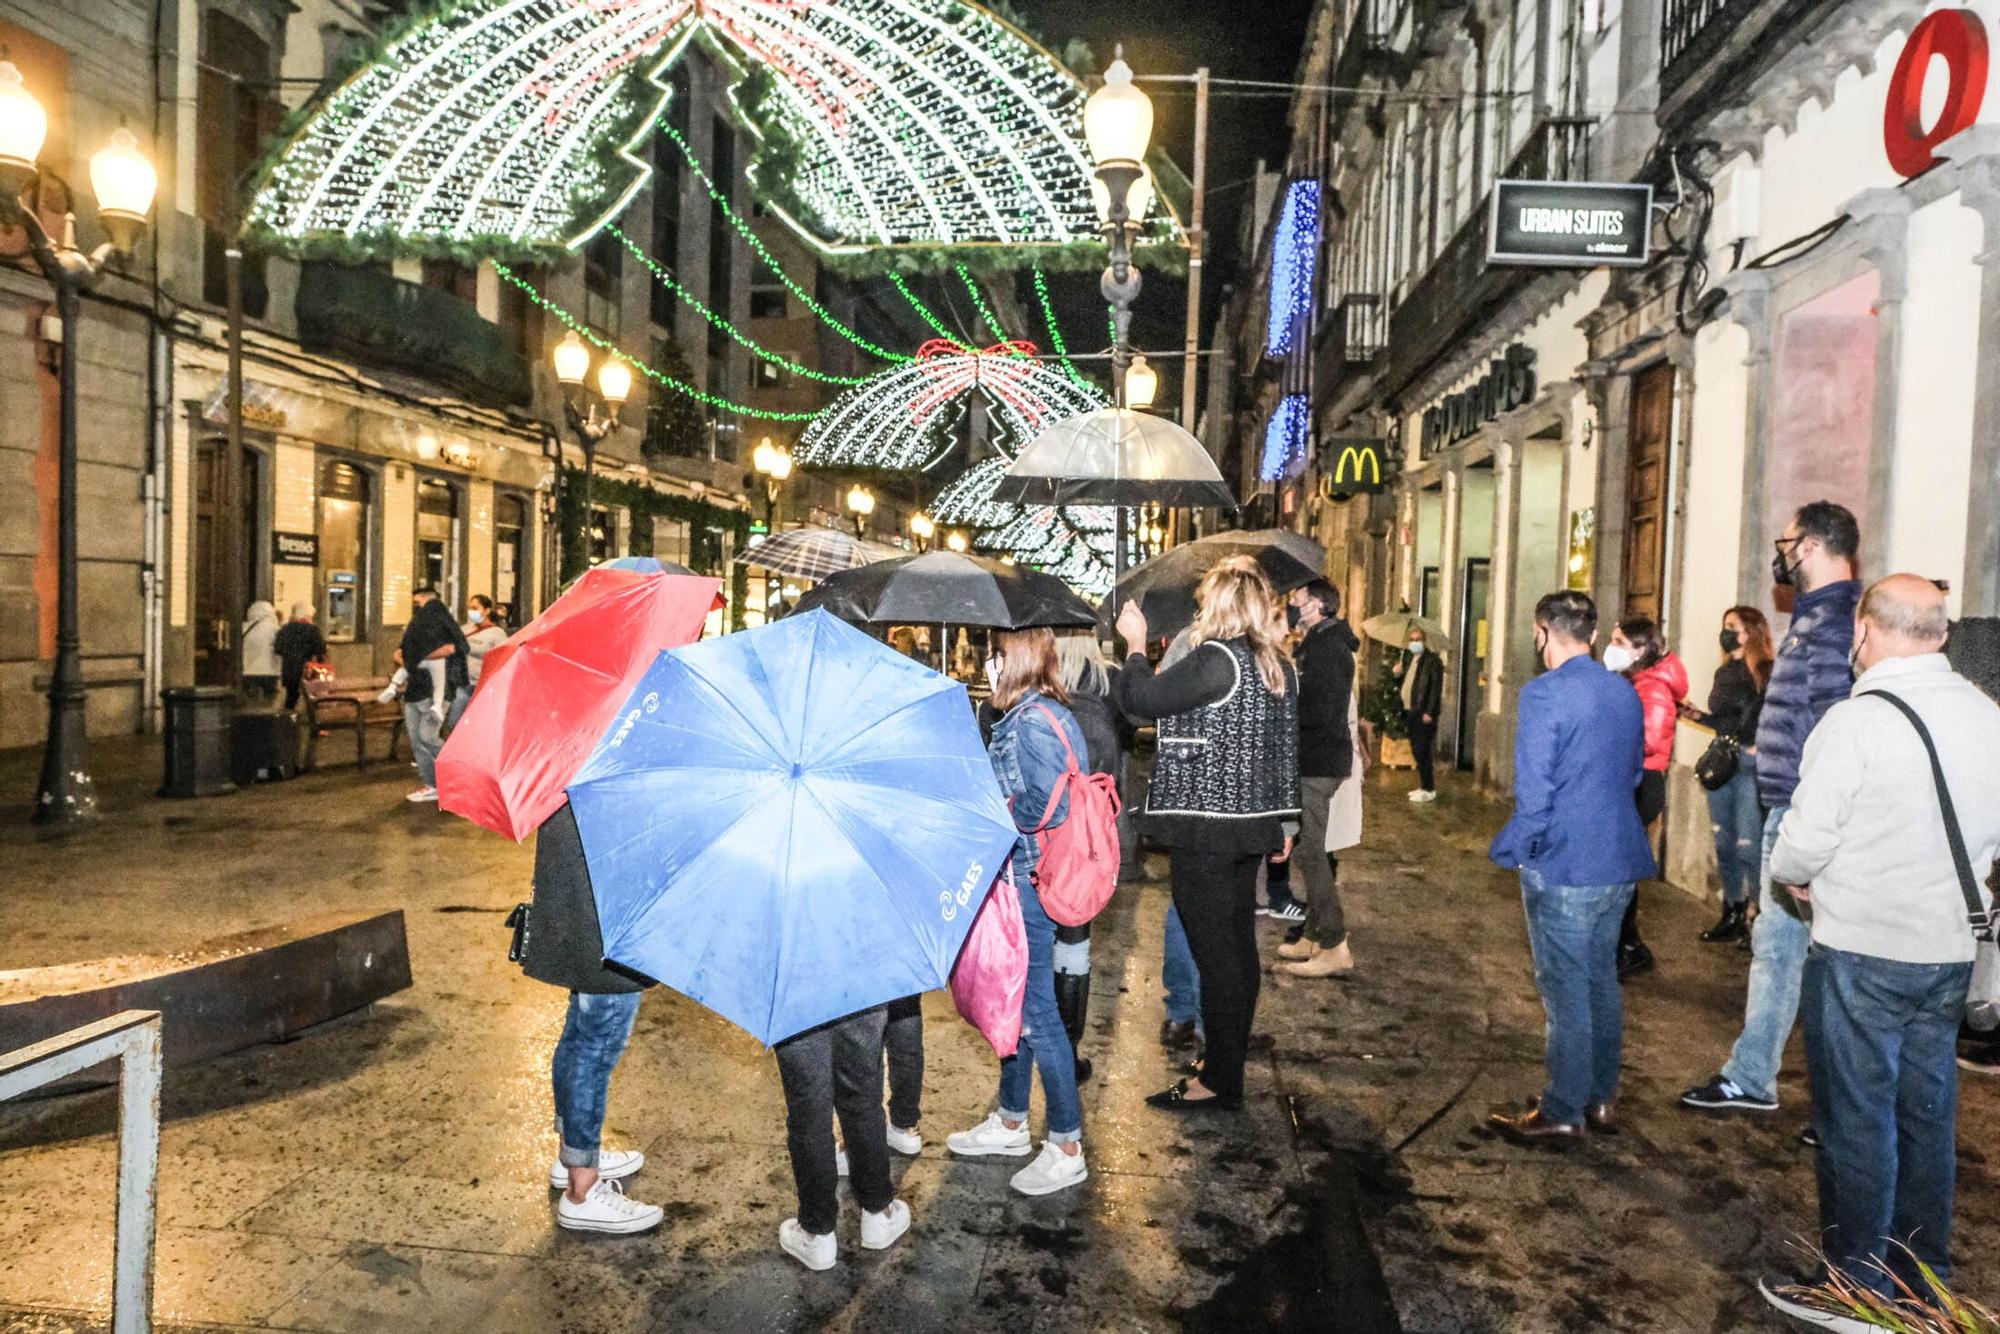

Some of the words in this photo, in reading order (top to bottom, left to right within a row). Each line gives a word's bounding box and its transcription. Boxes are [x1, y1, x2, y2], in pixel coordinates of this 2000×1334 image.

[1520, 207, 1573, 233] URBAN
[1574, 210, 1624, 235] SUITES
[609, 708, 641, 748] GAES
[956, 860, 983, 906] GAES
[1719, 1079, 1744, 1099] N
